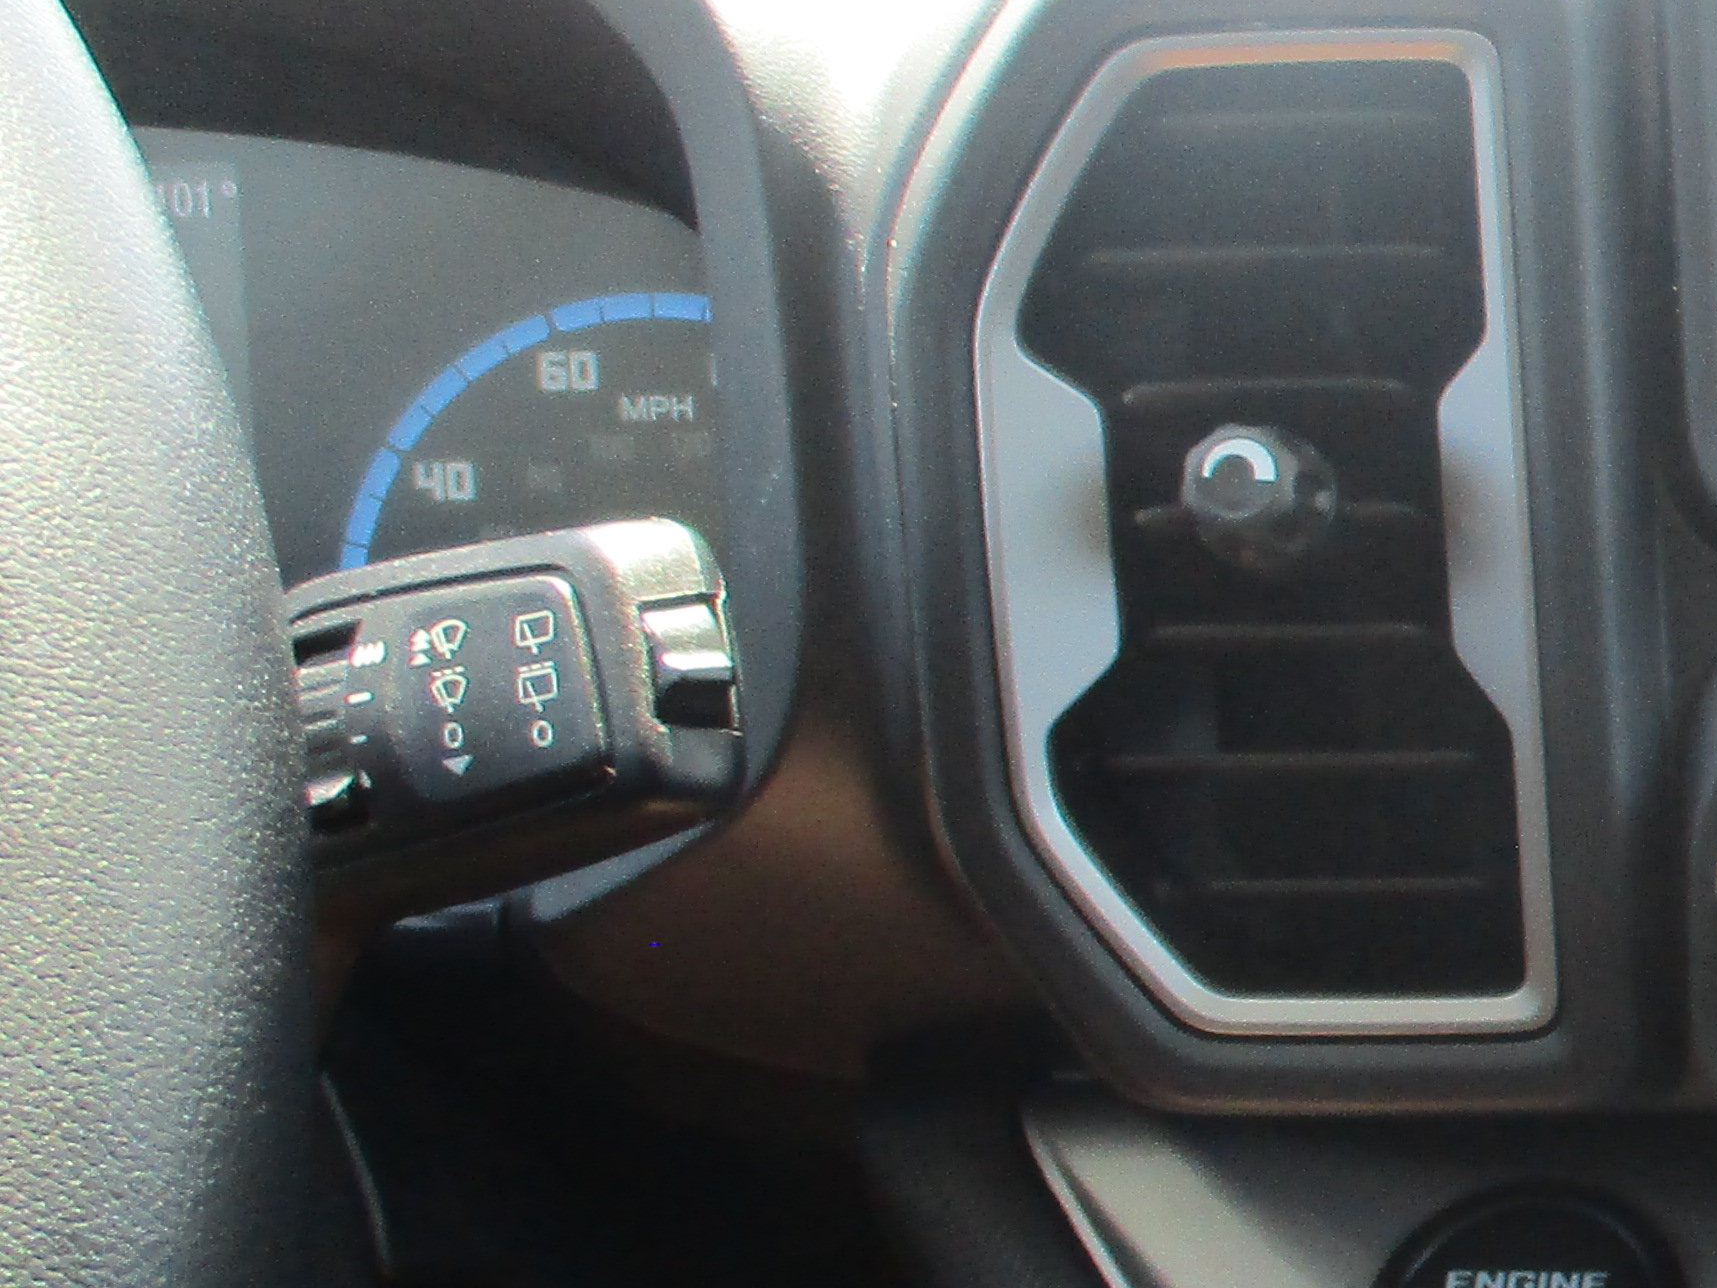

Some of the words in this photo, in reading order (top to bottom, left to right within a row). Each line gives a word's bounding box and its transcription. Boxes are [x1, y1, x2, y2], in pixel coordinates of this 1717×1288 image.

[536, 350, 598, 391] 60
[619, 394, 694, 422] MPH
[413, 460, 476, 501] 40
